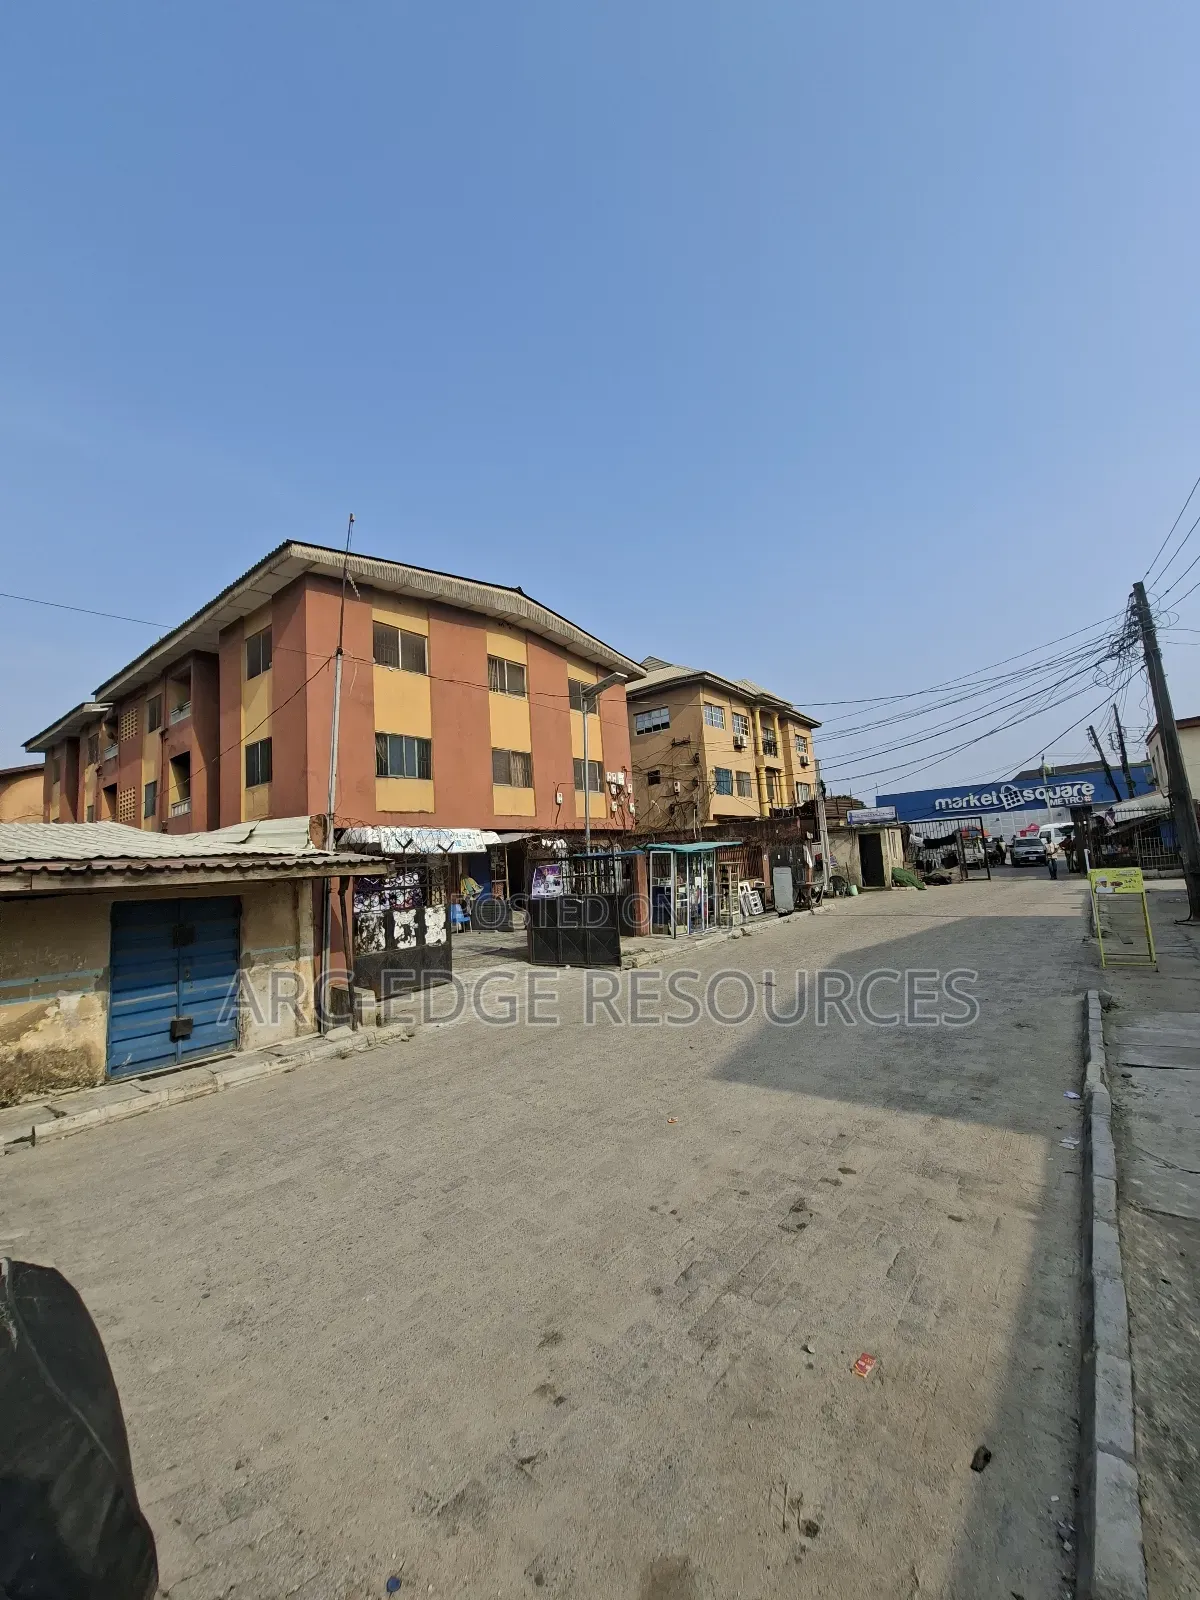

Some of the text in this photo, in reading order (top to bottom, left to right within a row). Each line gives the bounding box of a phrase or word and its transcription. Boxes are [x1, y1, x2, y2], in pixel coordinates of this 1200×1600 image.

[935, 783, 1095, 810] market square
[1049, 795, 1083, 806] METRO
